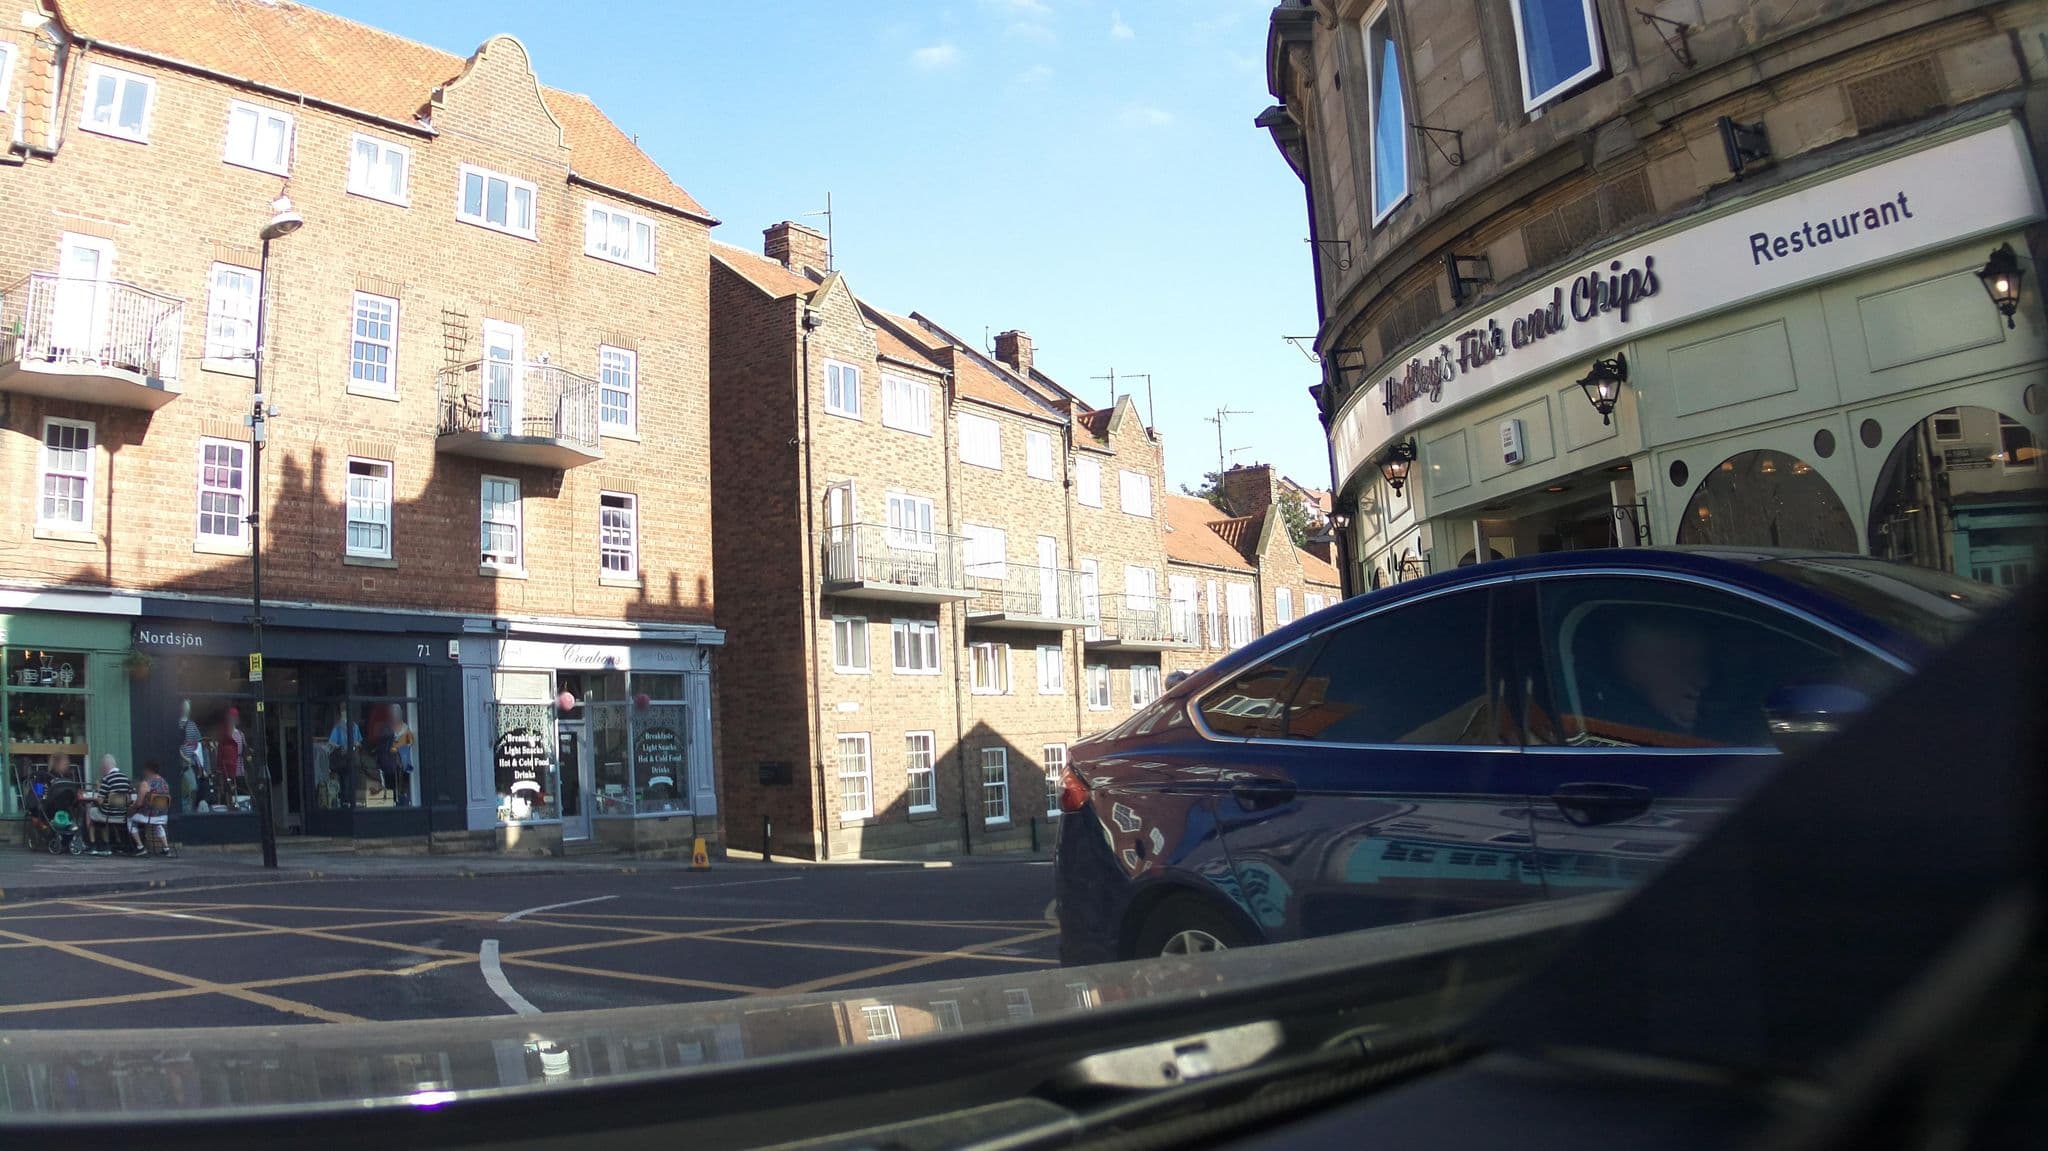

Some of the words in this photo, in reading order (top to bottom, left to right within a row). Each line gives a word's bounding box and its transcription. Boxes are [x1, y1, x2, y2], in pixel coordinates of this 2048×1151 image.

[1749, 191, 1913, 266] Restaurant
[1455, 318, 1506, 374] Fish
[1511, 286, 1564, 350] and
[1570, 255, 1660, 323] Chips
[417, 644, 431, 658] 71
[504, 746, 521, 756] Light
[518, 759, 533, 768] Cold
[534, 758, 550, 767] Food
[514, 770, 536, 780] Drinks
